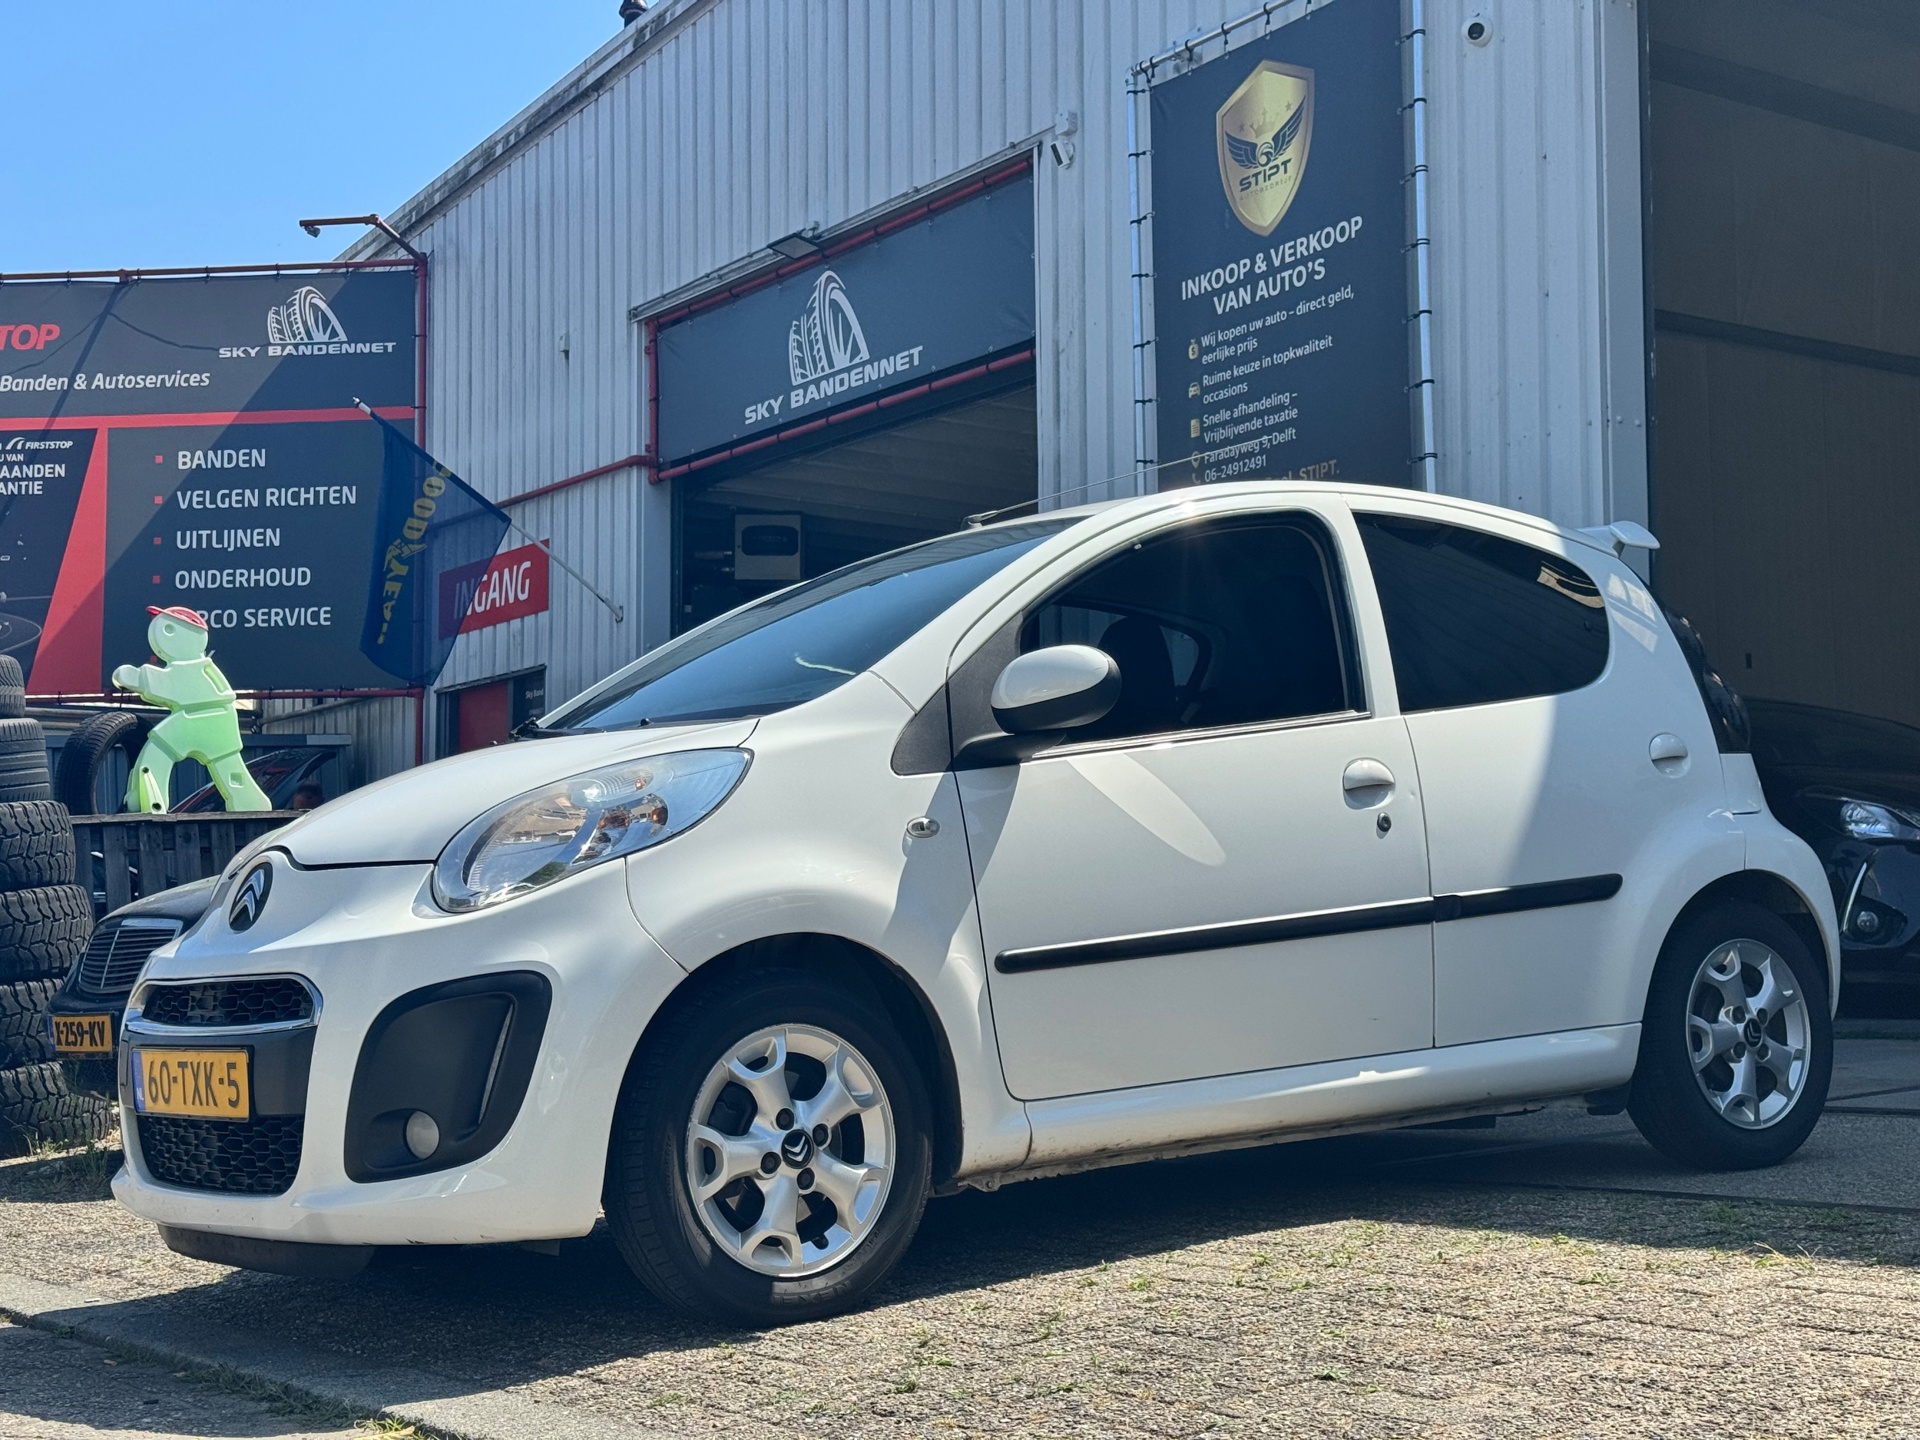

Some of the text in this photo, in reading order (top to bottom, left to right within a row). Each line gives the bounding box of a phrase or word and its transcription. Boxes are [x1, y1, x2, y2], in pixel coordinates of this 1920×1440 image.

[1239, 158, 1292, 193] STIPT
[1181, 216, 1363, 301] INKOOP & VERKOOP
[1213, 258, 1326, 315] VAN AUTO'S
[1201, 333, 1216, 348] Wij
[1218, 323, 1247, 343] kopen
[1249, 318, 1264, 332] uw
[1265, 310, 1287, 327] auto
[1296, 295, 1326, 316] direct
[1328, 284, 1354, 308] geld,
[218, 341, 397, 358] SKY BANDENNET
[1202, 336, 1258, 365] eerlijke prijs
[1203, 335, 1333, 387] Ruime keuze in topkwaliteit
[0, 370, 211, 392] Banden & Autoservices
[745, 345, 924, 425] SKY BANDENNET
[1203, 382, 1248, 404] occasions
[1203, 408, 1231, 427] Snelle
[1233, 392, 1290, 418] afhandeling
[1204, 406, 1298, 443] Vrijblijvende taxatie
[6, 453, 24, 463] VAN
[25, 440, 74, 450] FIRSTSTOP
[177, 448, 266, 470] BANDEN
[1204, 440, 1260, 465] Faradayweg
[1272, 427, 1297, 445] Delft
[1204, 454, 1267, 482] 06-24912491
[176, 486, 357, 510] VELGEN RICHTEN
[176, 528, 281, 551] UITLIJNEN
[175, 567, 311, 590] ONDERHOUD
[453, 561, 532, 620] INGANG
[244, 606, 331, 628] SERVICE
[148, 1059, 241, 1108] 60-TXK-5
